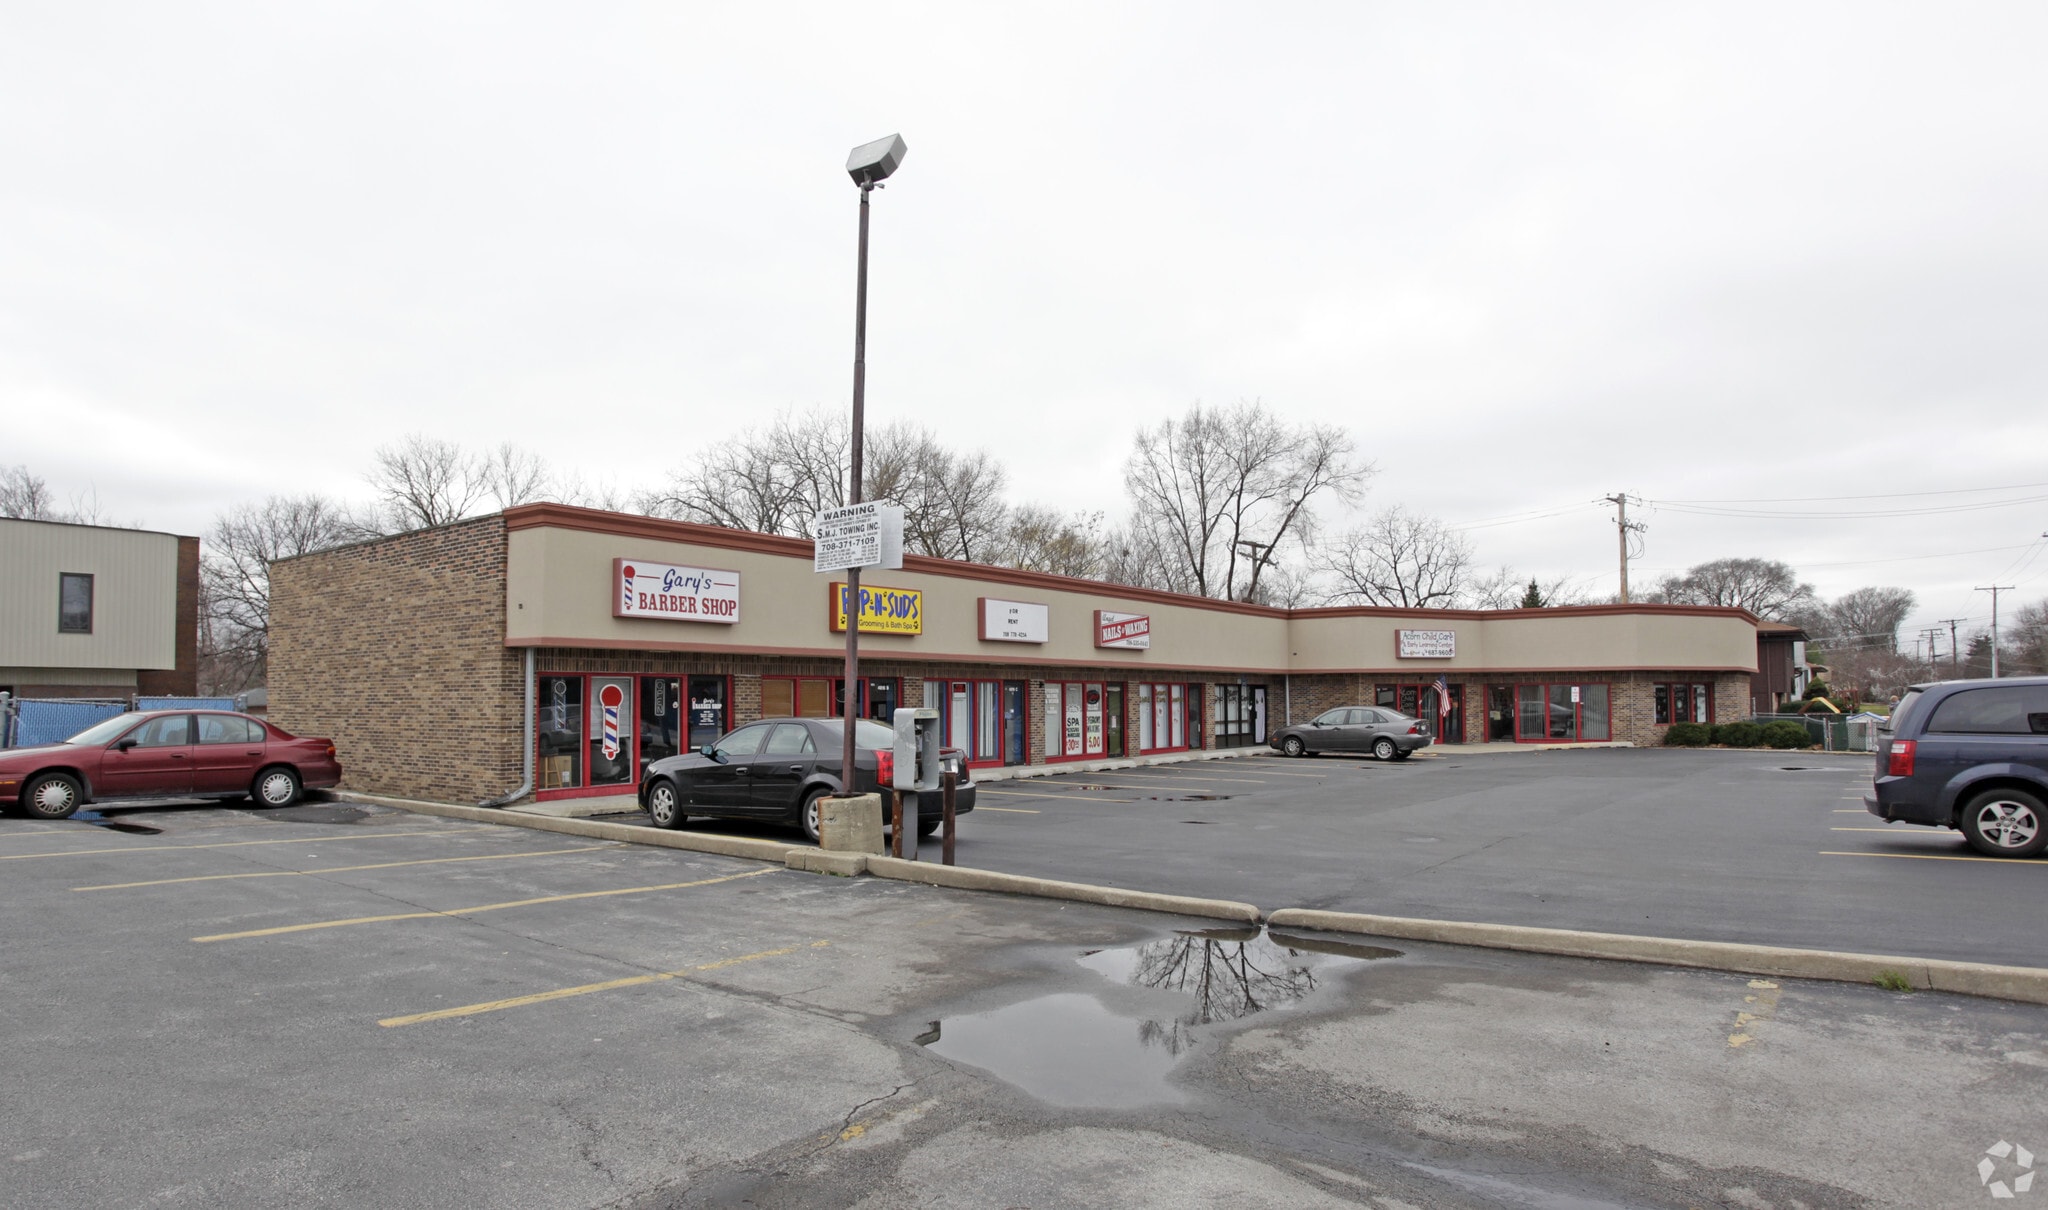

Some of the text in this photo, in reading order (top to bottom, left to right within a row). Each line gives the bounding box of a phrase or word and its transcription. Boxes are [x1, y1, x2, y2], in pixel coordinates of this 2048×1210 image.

[824, 505, 875, 520] WARNING
[817, 528, 838, 539] S.M.J.
[840, 524, 865, 536] TOWING
[867, 522, 880, 531] INC.
[822, 537, 875, 551] 708-371-7109
[662, 568, 712, 595] Gary's
[638, 592, 737, 616] BARBER SHOP
[841, 587, 919, 619] PP-N-SUDS
[858, 619, 885, 629] Grooming
[902, 622, 912, 630] Spa
[1103, 625, 1121, 641] NAILS
[1125, 619, 1148, 636] WAXING
[1403, 632, 1453, 641] Acorn Child Care
[1419, 641, 1438, 649] Learning
[1067, 717, 1079, 726] SPA
